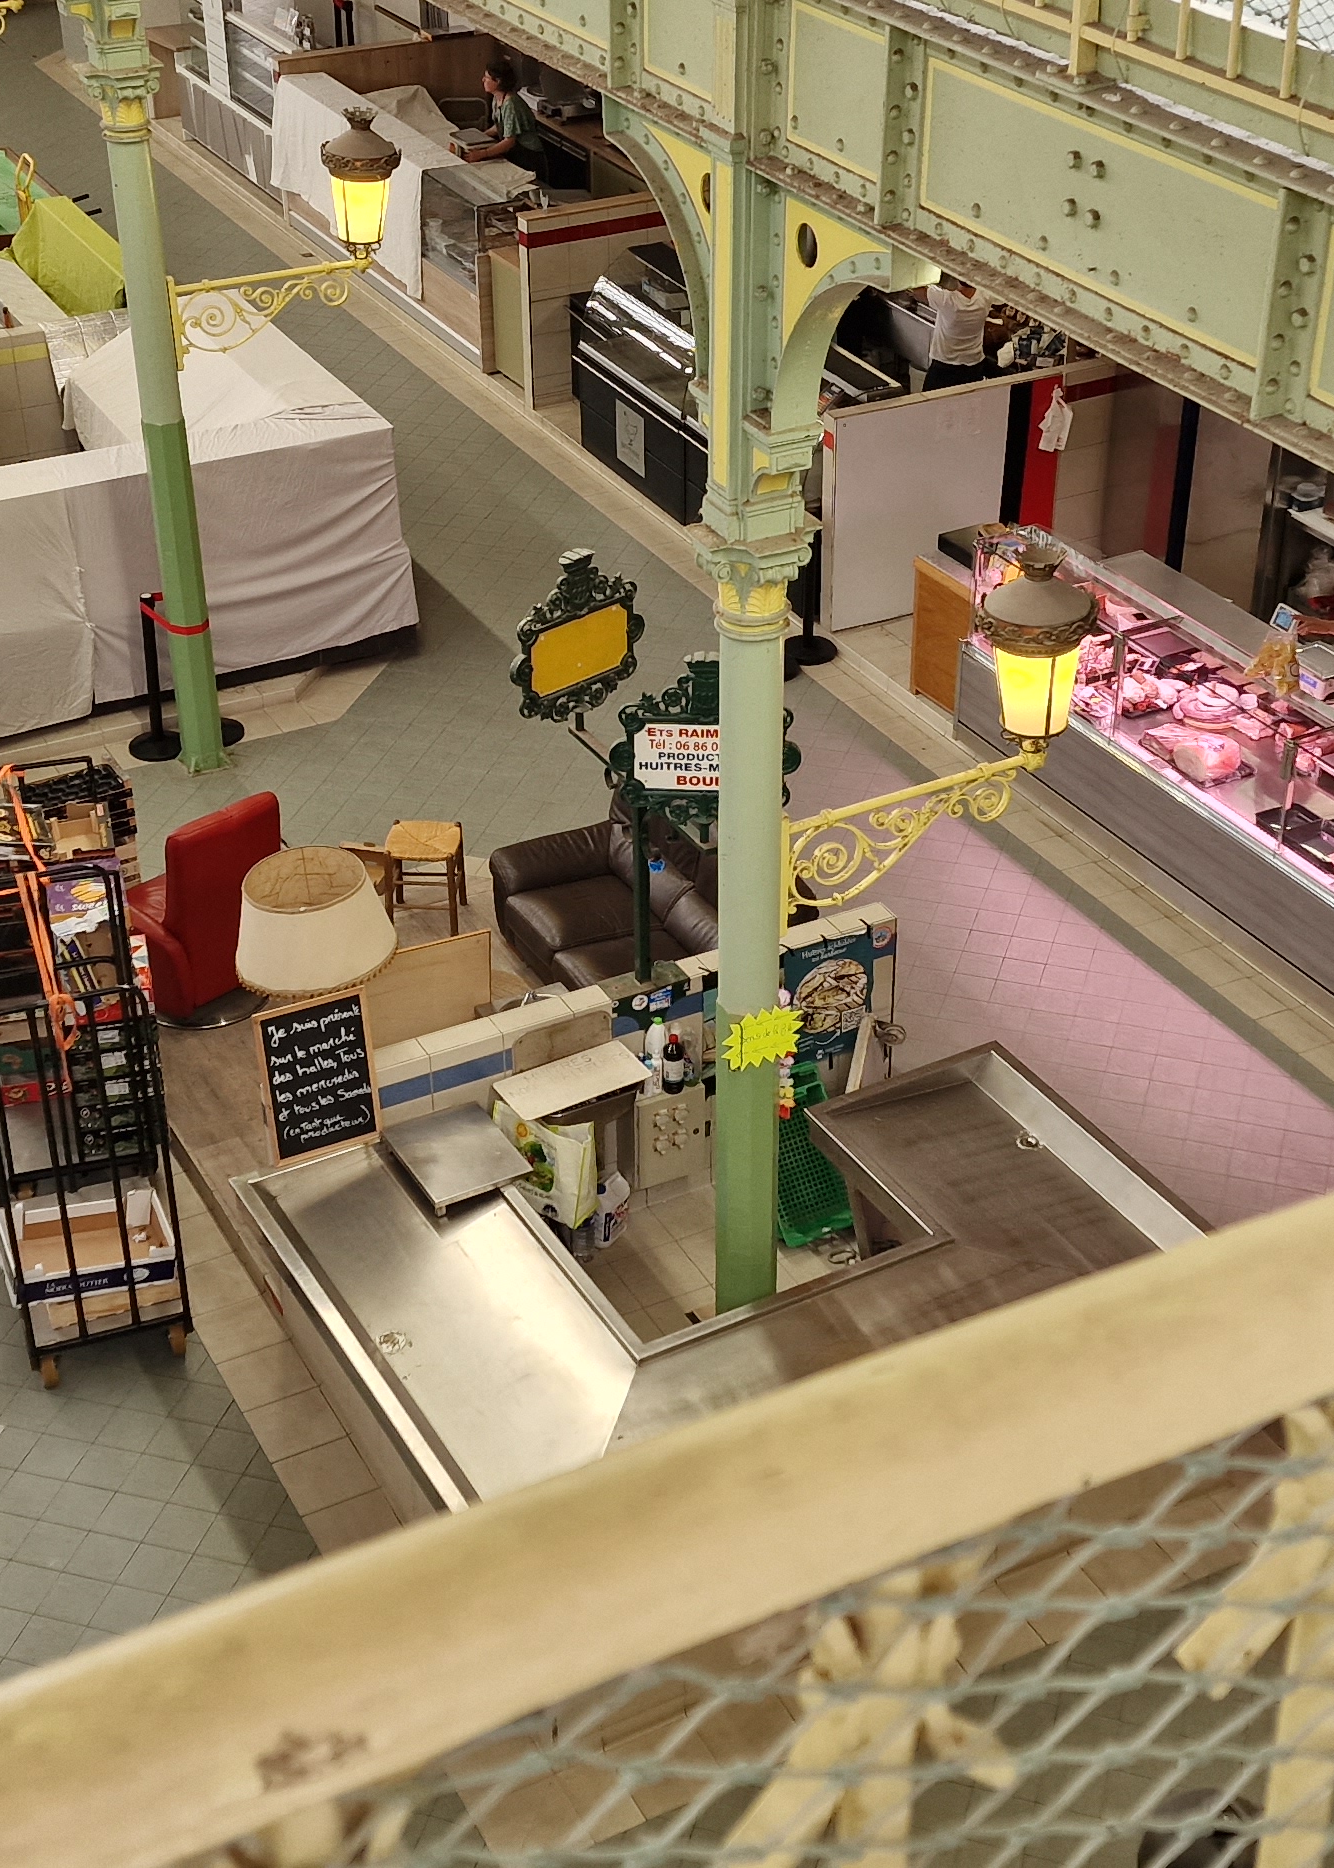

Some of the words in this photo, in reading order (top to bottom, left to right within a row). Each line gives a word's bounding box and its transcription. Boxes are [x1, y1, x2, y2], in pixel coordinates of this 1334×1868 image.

[649, 739, 666, 749] Tél
[675, 741, 690, 751] 06
[693, 742, 708, 751] 86
[267, 1025, 288, 1047] Je
[290, 1019, 318, 1034] suis
[270, 1053, 293, 1067] sur
[294, 1045, 307, 1059] le
[309, 1027, 356, 1055] marché
[272, 1070, 293, 1085] des
[276, 1090, 293, 1103] les
[296, 1068, 359, 1097] mercredis
[278, 1107, 291, 1122] et
[318, 1095, 335, 1106] les
[323, 1114, 346, 1127] que
